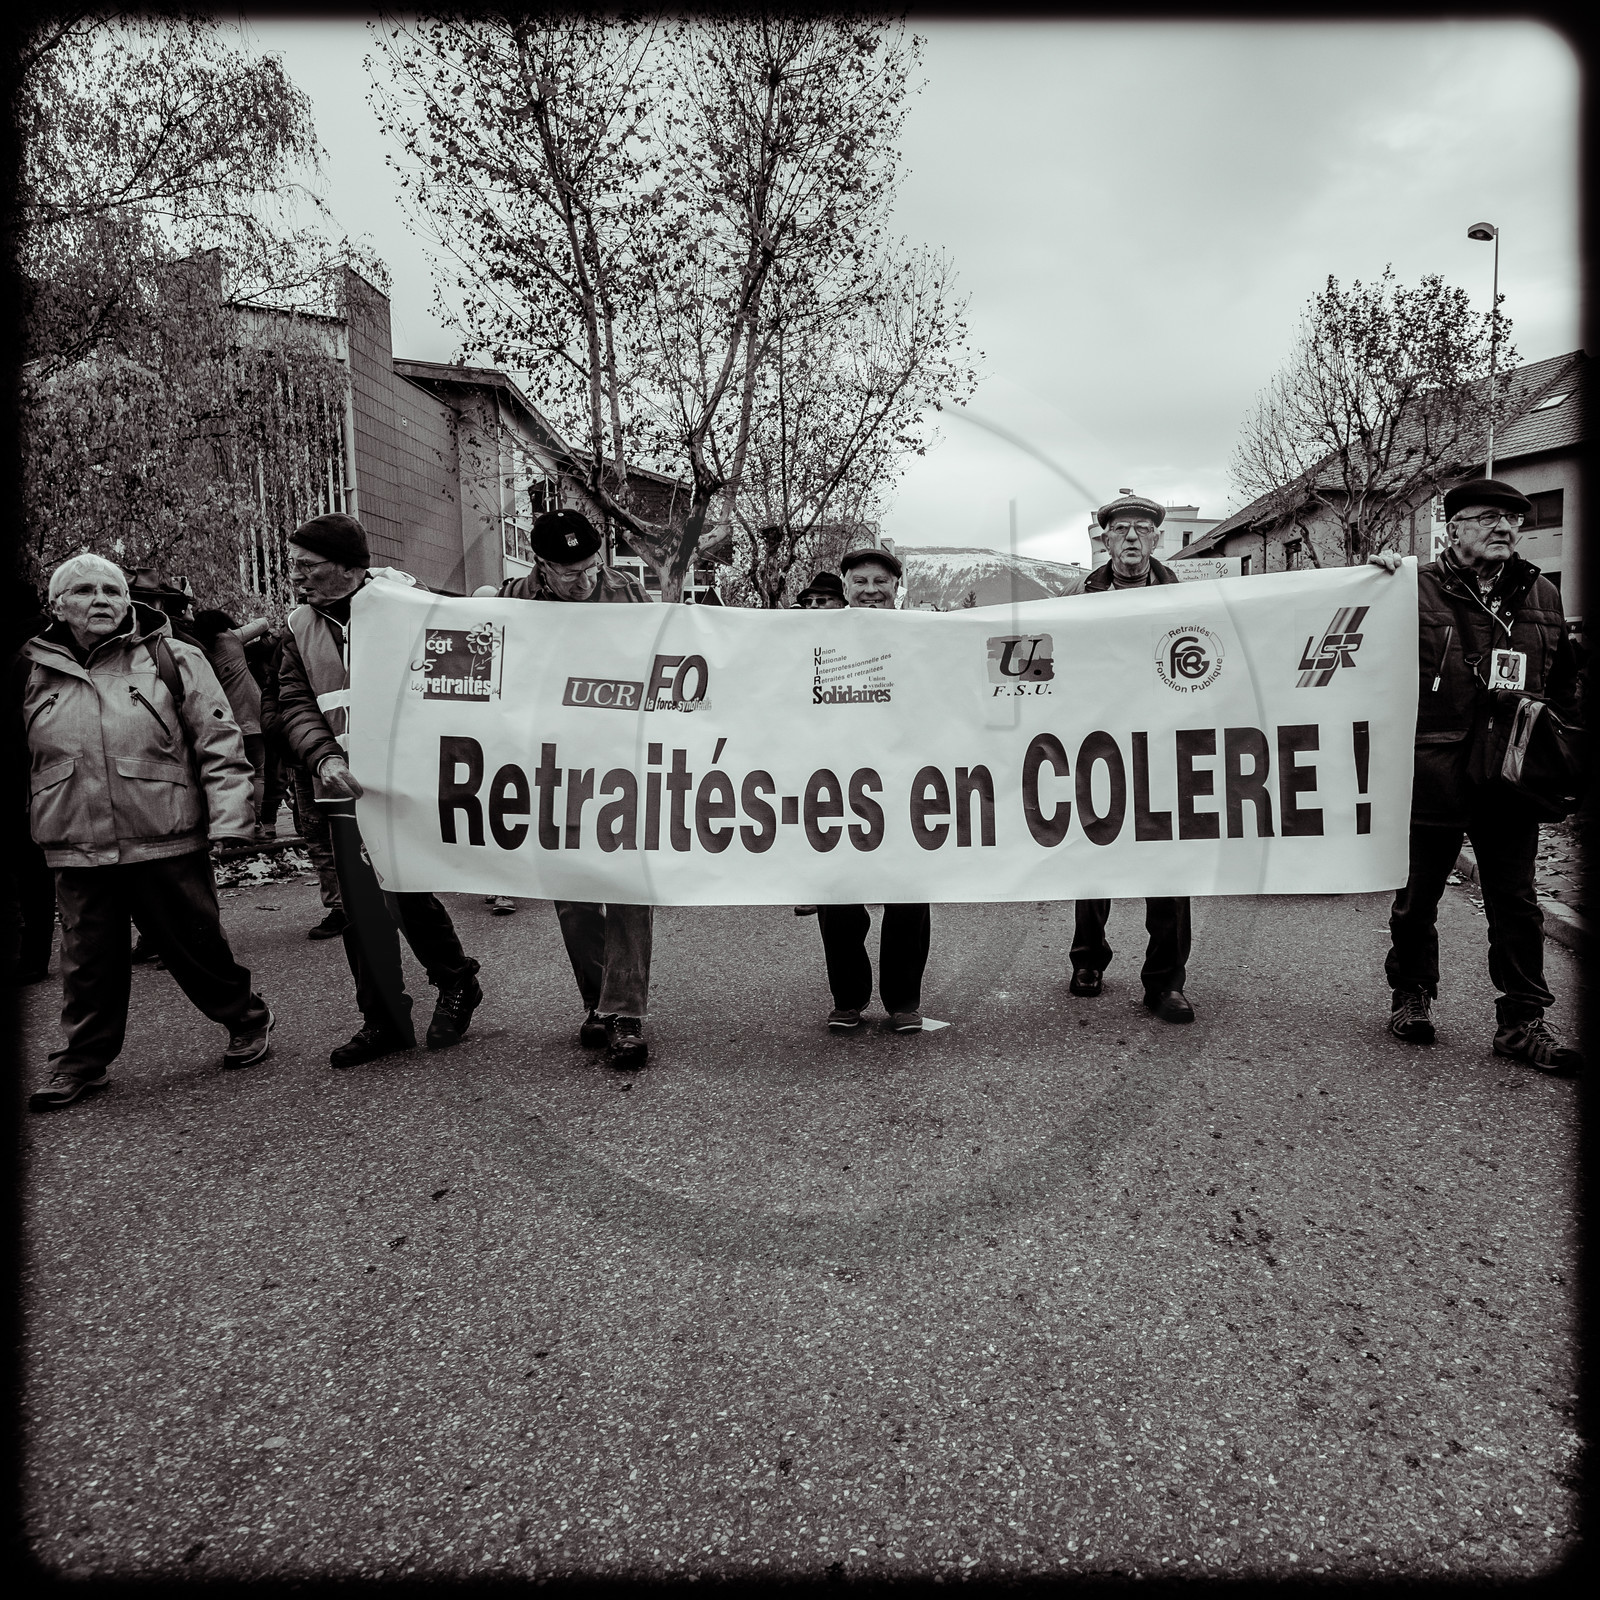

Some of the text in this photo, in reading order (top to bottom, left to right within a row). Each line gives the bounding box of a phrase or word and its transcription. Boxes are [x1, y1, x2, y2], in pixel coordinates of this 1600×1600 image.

[1168, 625, 1211, 639] Retraités
[426, 638, 453, 654] cgt
[814, 646, 836, 657] Union
[1298, 633, 1364, 671] LSR
[814, 655, 847, 666] Nationale
[880, 653, 892, 661] des
[644, 654, 709, 713] FO
[1155, 657, 1223, 693] Fonction Publique
[424, 675, 491, 696] retraités
[571, 681, 636, 707] UCR
[812, 685, 891, 704] Solidaires
[992, 683, 1052, 697] F.S.U.
[911, 764, 996, 852] en
[1022, 723, 1325, 847] COLERE
